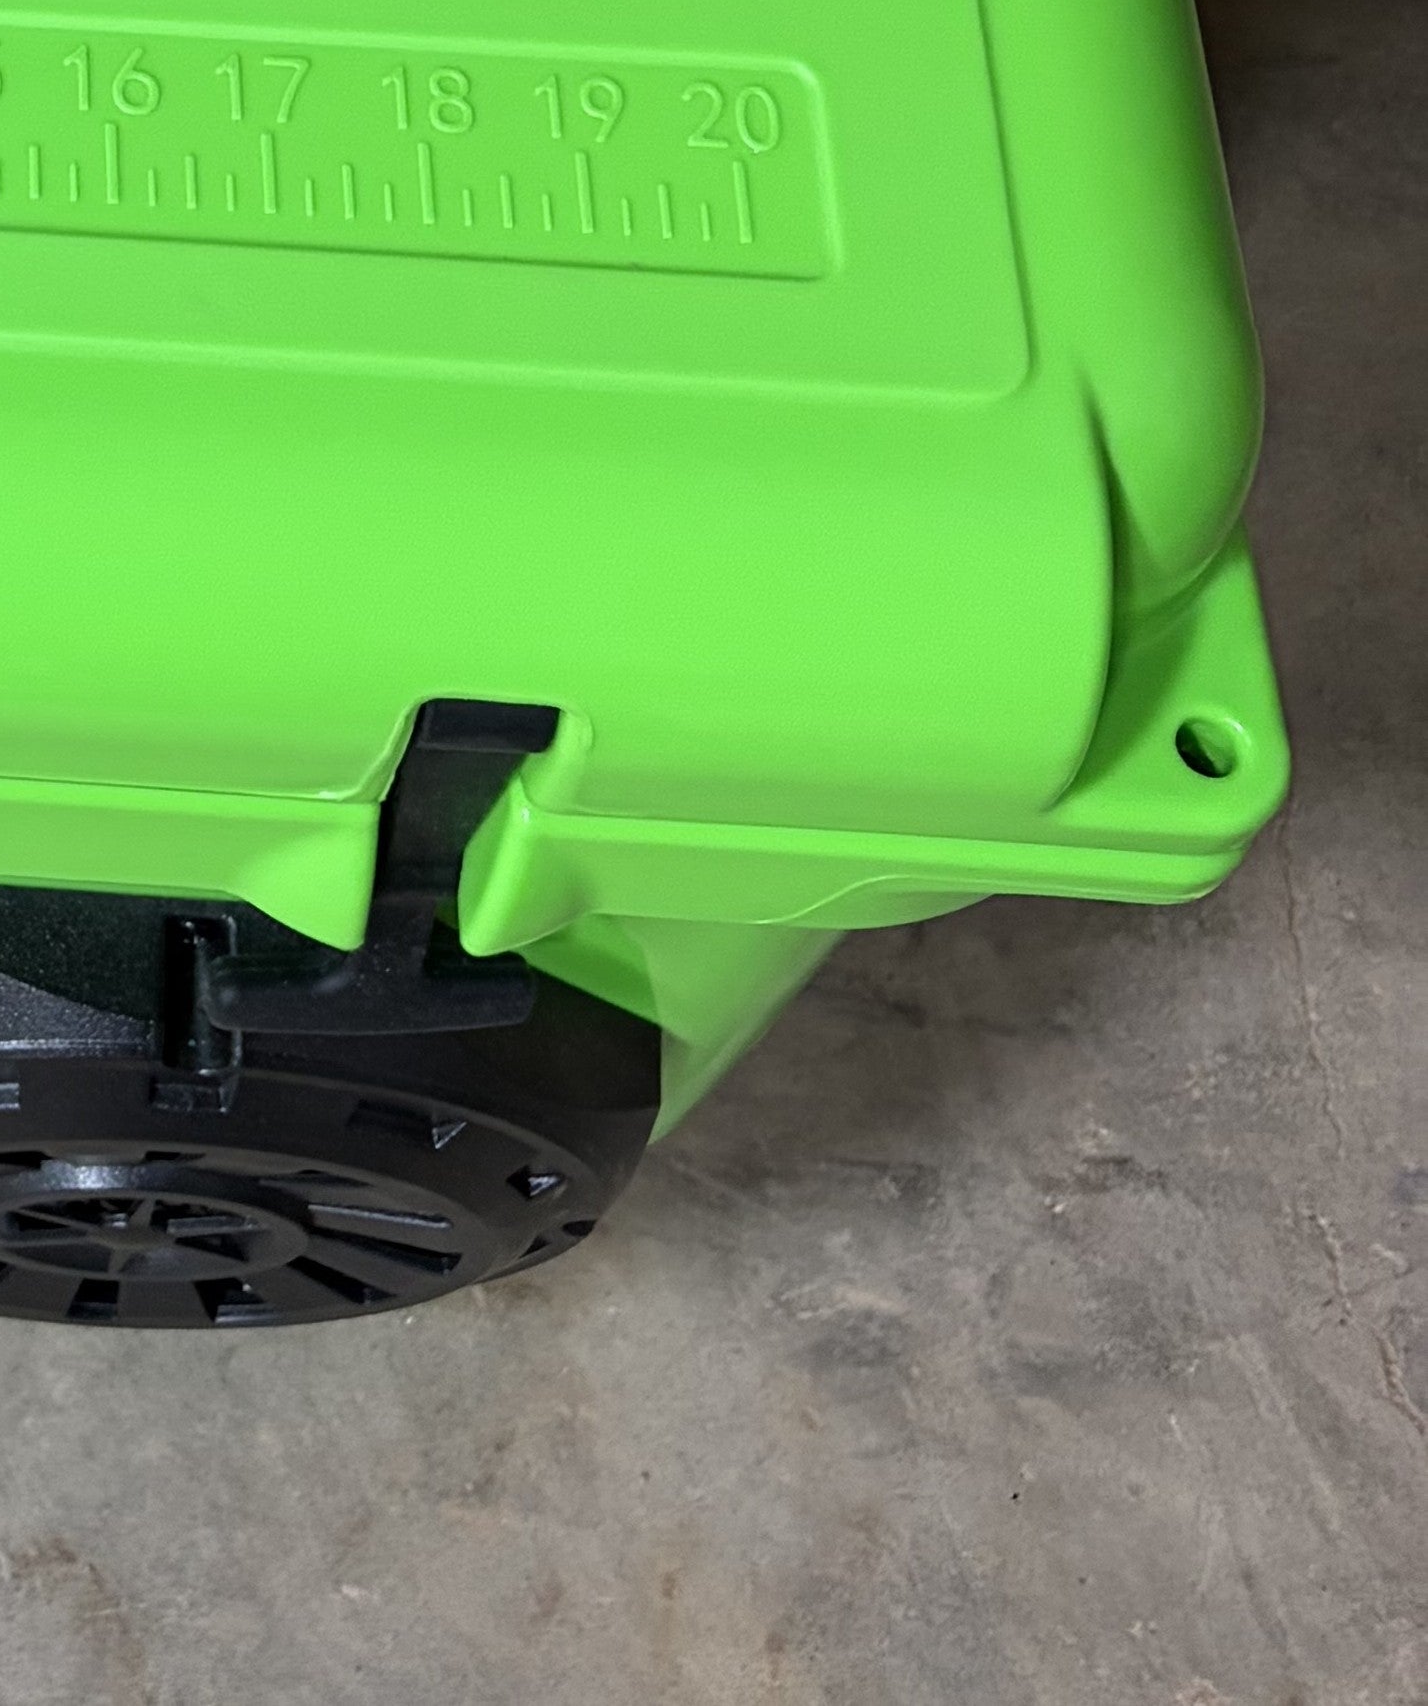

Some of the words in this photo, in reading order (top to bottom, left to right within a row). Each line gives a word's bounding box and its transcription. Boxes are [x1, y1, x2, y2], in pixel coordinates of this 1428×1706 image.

[61, 44, 162, 117] 16
[214, 52, 313, 125] 17
[380, 65, 477, 135] 18
[533, 73, 626, 143] 19
[680, 81, 781, 154] 20
